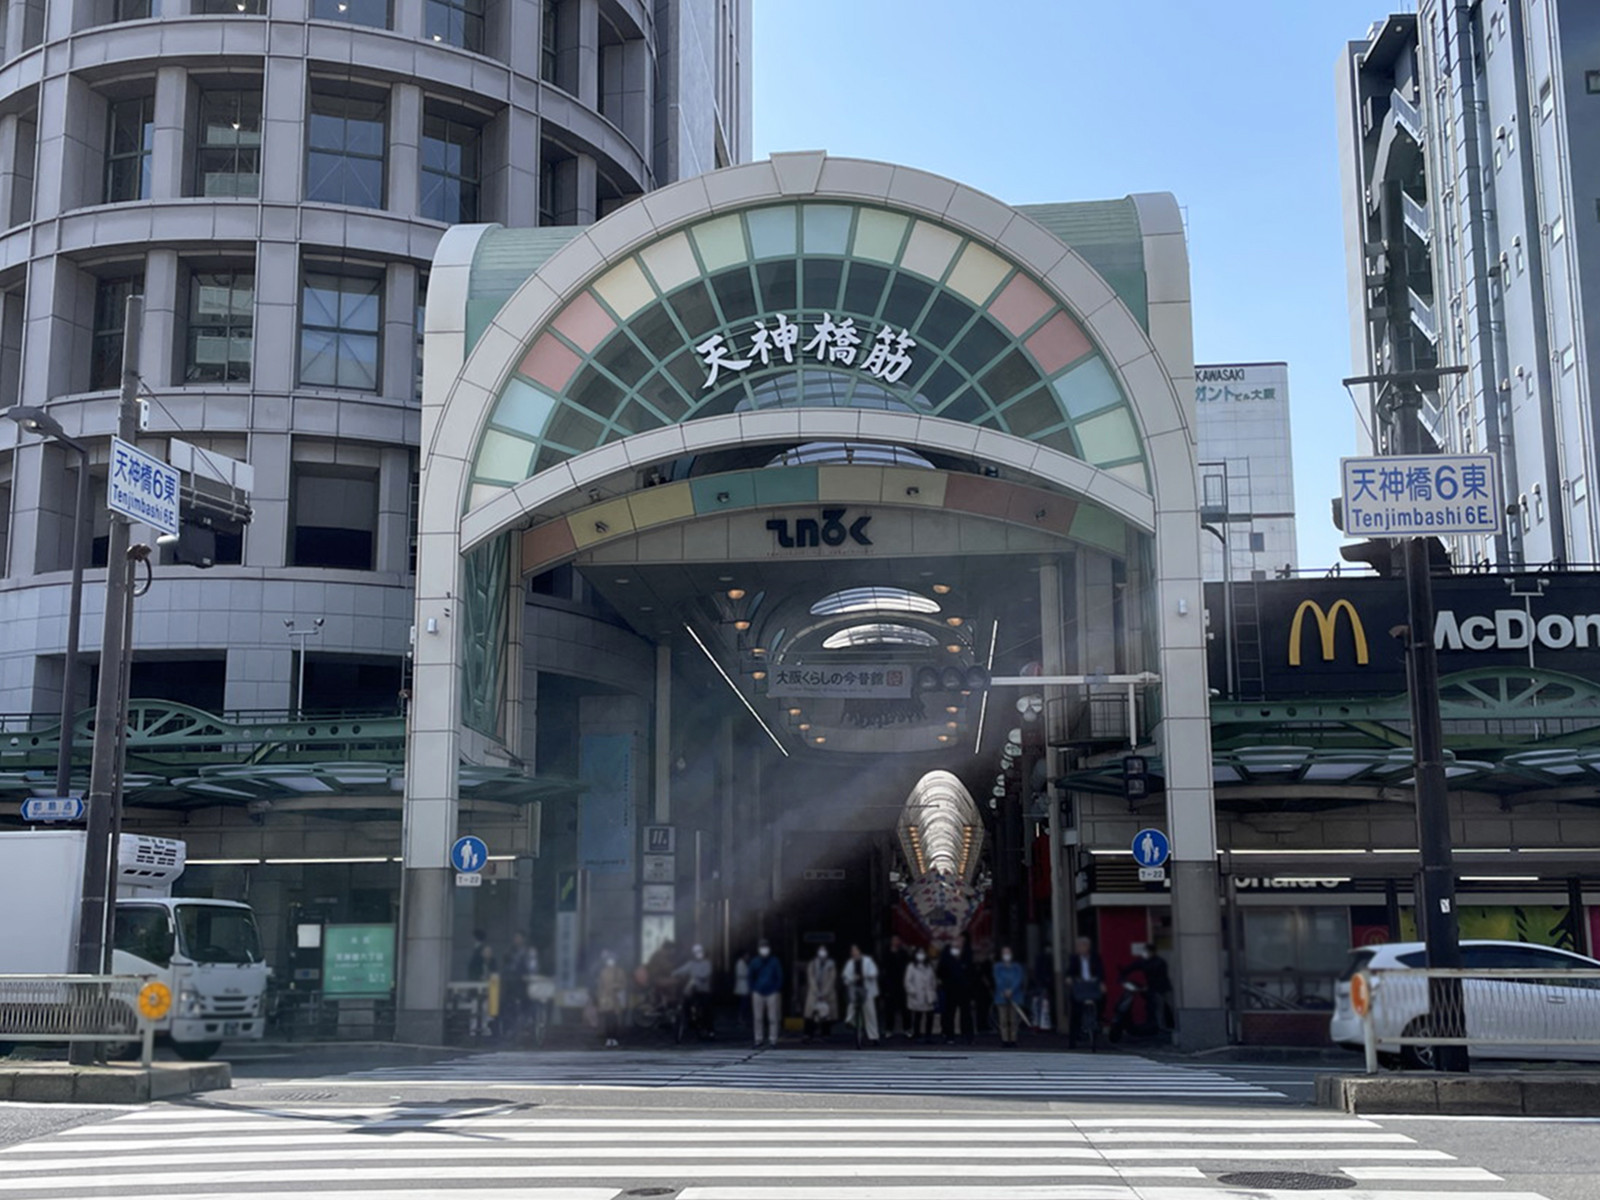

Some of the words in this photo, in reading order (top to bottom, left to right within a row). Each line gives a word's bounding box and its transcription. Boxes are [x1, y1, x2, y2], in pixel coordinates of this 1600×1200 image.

[696, 312, 916, 389] 天神橋筋
[1195, 368, 1245, 382] KAWASAKI
[114, 450, 176, 506] 天神橋6東
[1352, 463, 1489, 502] 天神橋6東
[113, 484, 163, 522] Tenjimbashi
[1352, 507, 1462, 531] Tenjimbashi
[776, 671, 884, 686] 大阪くらしの今昔館
